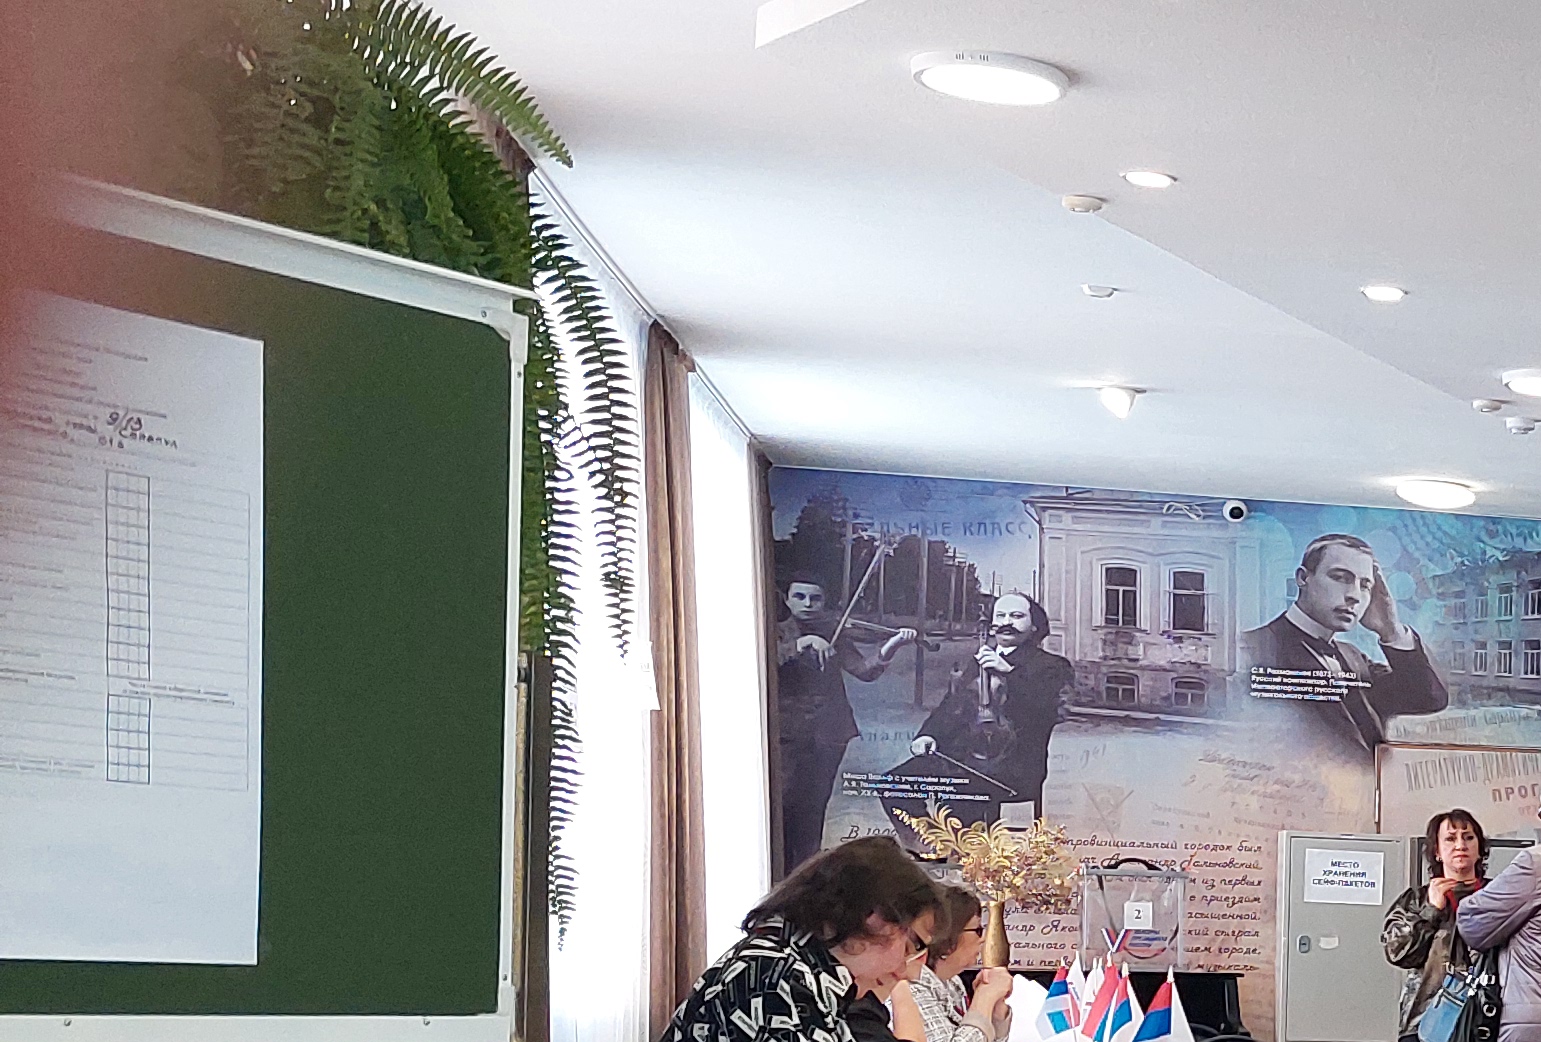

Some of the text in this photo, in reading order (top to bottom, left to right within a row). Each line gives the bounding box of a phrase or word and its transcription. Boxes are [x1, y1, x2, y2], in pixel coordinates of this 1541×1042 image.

[1492, 782, 1541, 802] ПРОГ
[1237, 840, 1262, 852] был
[1331, 860, 1359, 869] МЕСТО
[1322, 869, 1366, 878] ХРАНЕНИЯ
[1312, 878, 1375, 888] СЕЙФ-ПАКЕТОВ
[1134, 909, 1143, 919] 2
